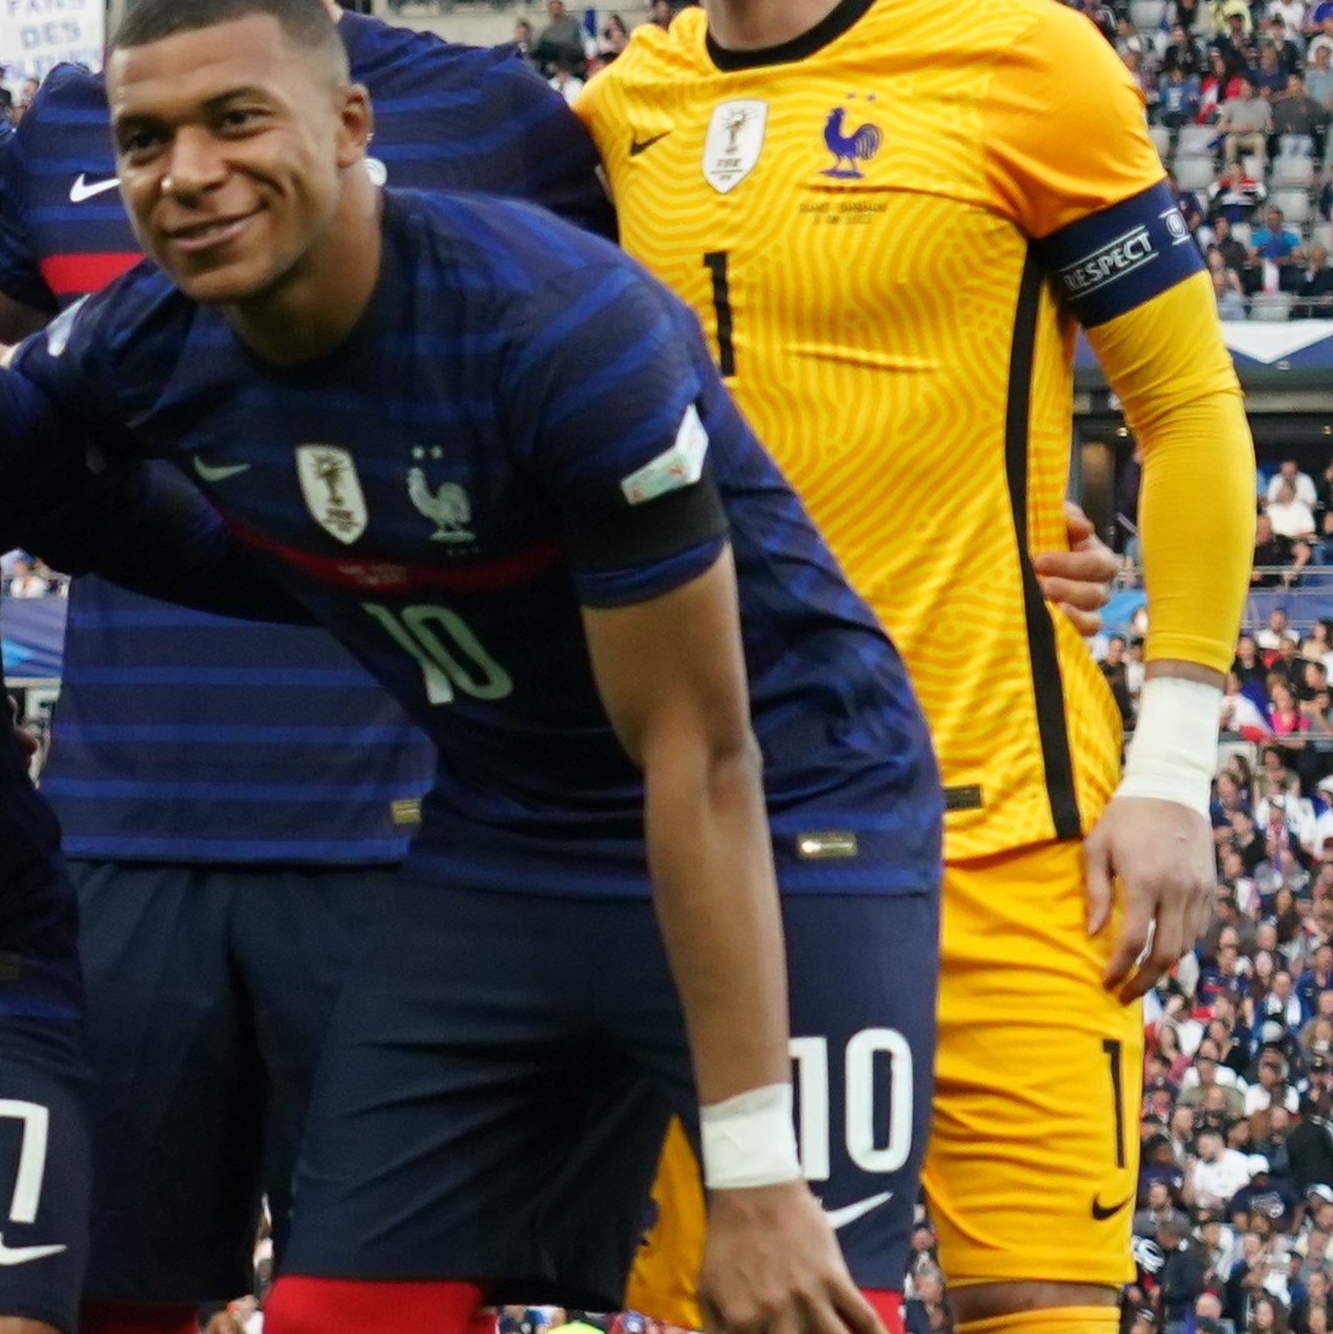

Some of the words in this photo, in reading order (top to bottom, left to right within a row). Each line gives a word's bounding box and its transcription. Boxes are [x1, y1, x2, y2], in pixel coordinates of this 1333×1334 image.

[20, 17, 82, 50] DES
[703, 251, 735, 377] 1
[1063, 231, 1154, 290] RESPECT
[362, 602, 513, 704] 10
[789, 1027, 913, 1181] 10
[1102, 1038, 1127, 1170] 1
